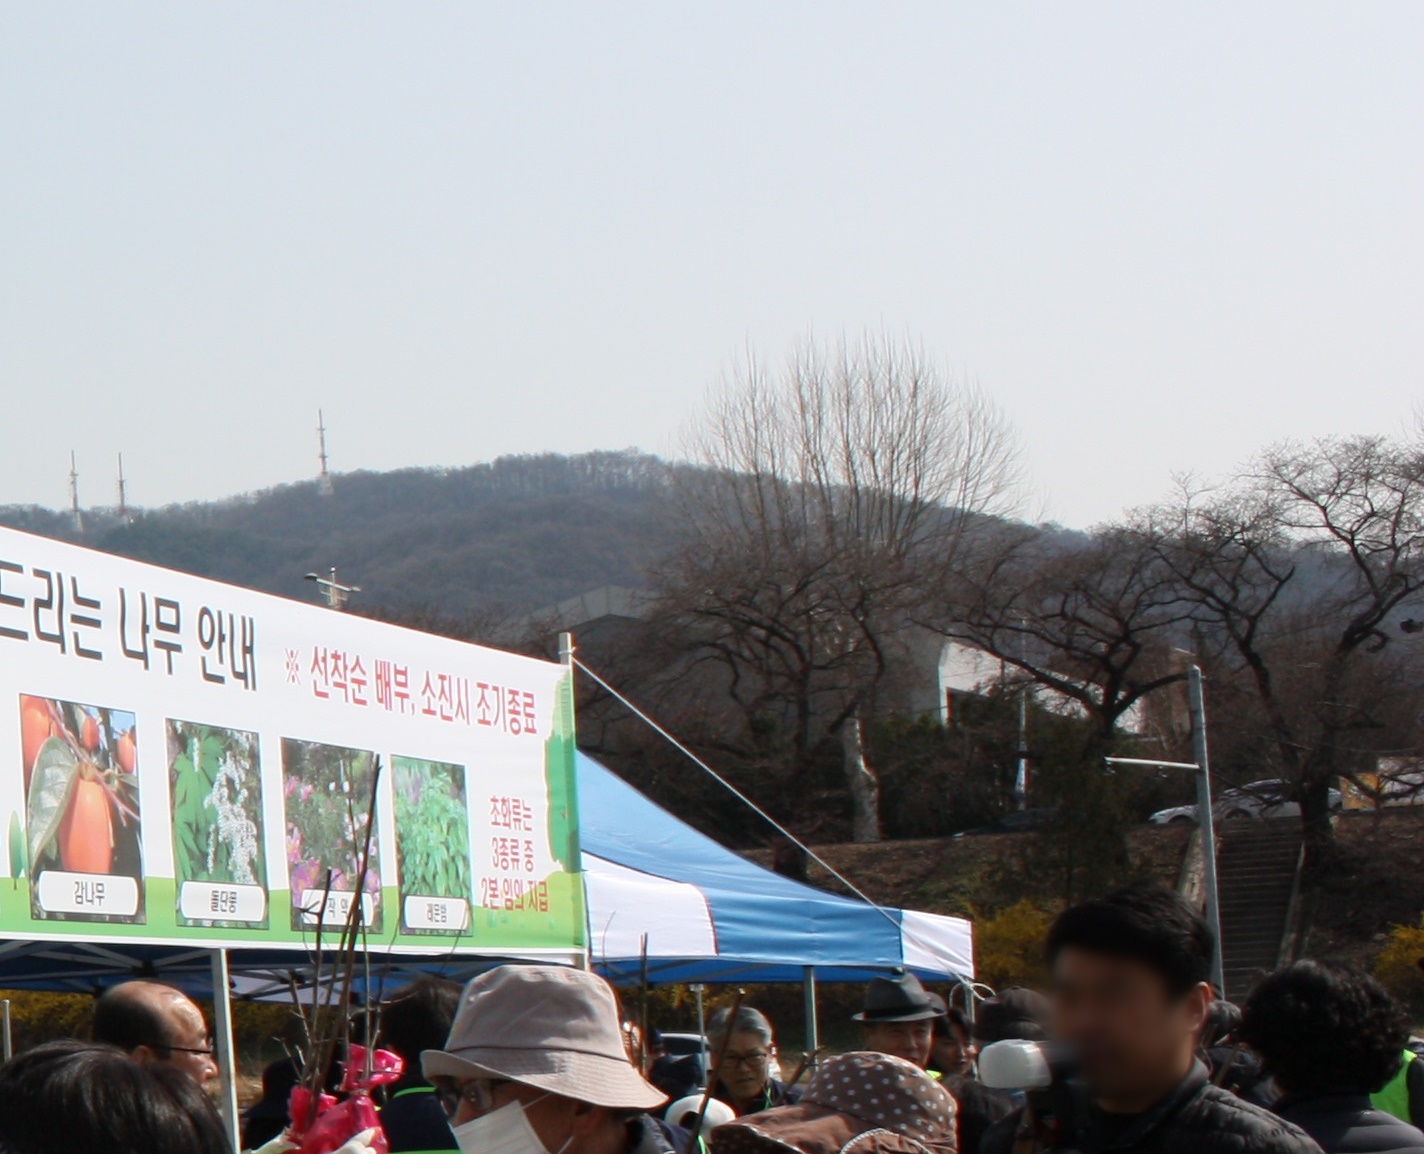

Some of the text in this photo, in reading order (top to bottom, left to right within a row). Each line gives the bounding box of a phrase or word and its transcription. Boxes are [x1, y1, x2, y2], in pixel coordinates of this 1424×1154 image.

[119, 586, 183, 677] 나무
[198, 604, 257, 692] 안내
[310, 646, 538, 737] 선착순 배부, 소진시 조기종료
[490, 796, 533, 831] 초화류는
[492, 837, 521, 871] 3종류
[73, 880, 106, 906] 감나무
[481, 878, 549, 913] 2본 임의 지급
